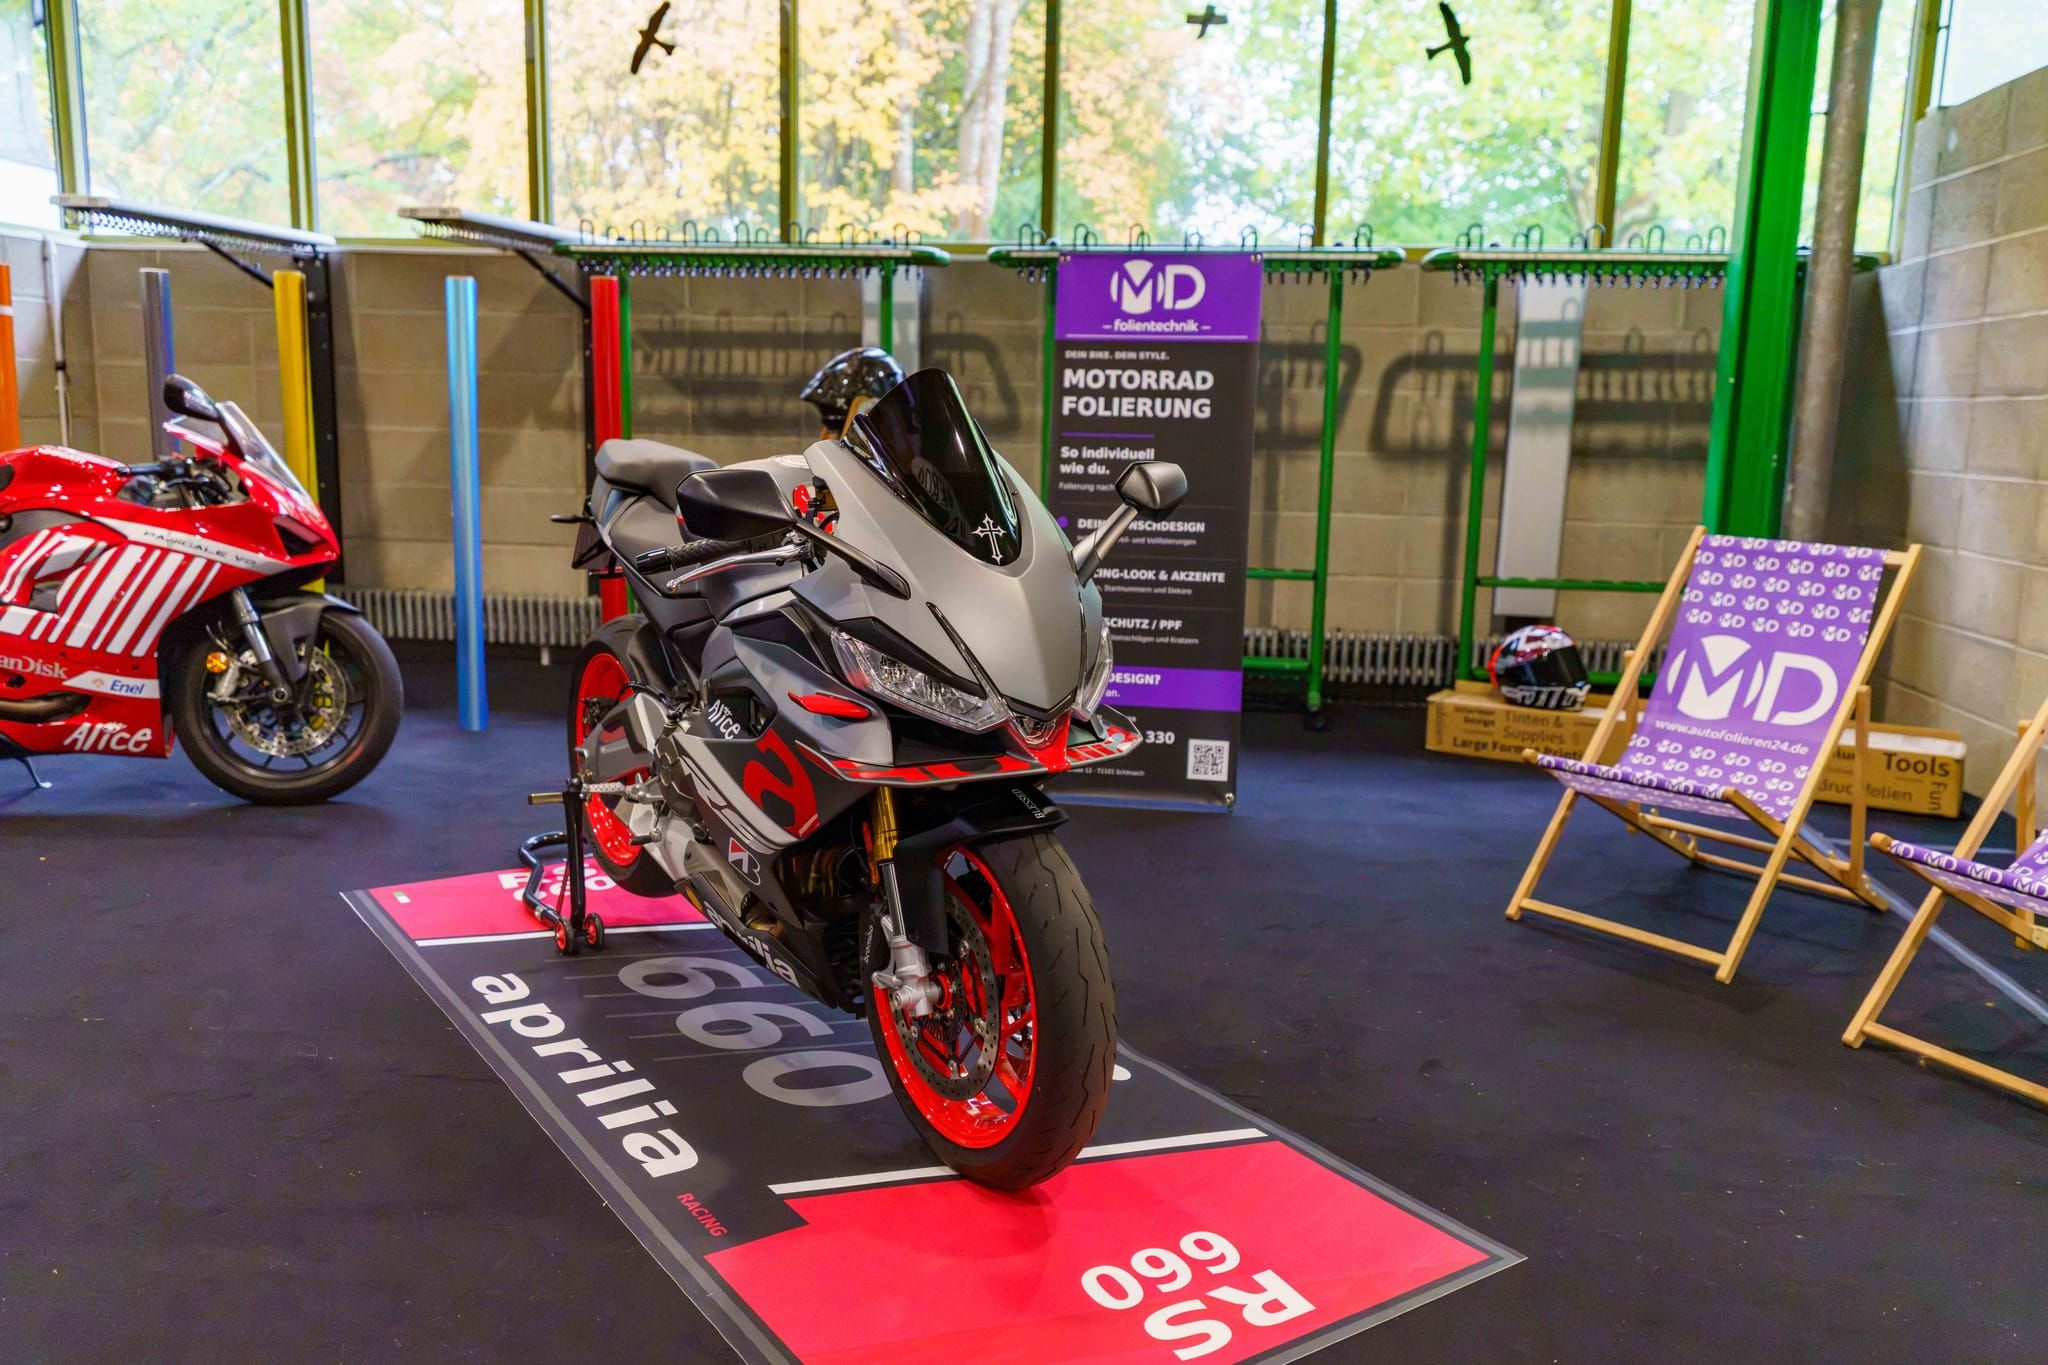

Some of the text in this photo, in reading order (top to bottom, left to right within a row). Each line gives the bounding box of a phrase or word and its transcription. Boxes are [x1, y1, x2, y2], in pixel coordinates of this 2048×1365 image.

[1110, 259, 1206, 315] MD
[1113, 318, 1199, 332] folientechnik
[1065, 350, 1170, 360] DEIN BIKE. DEIN STYLE.
[1063, 368, 1214, 391] MOTORRAD
[1061, 396, 1211, 419] FOLIERUNG
[1060, 446, 1155, 460] So individuell
[1059, 462, 1110, 475] wie du.
[1093, 568, 1225, 583] CING-LOOK & AKZENTE
[1104, 617, 1150, 629] SCHUTZ
[1159, 619, 1183, 631] PPF
[0, 655, 69, 679] anDisk
[110, 679, 145, 695] Enel
[1666, 634, 1838, 726] MD
[707, 699, 741, 739] Alice
[64, 721, 152, 753] Alice
[1145, 730, 1175, 745] 330
[1655, 719, 1809, 755] www.autofolieren24.de
[1882, 751, 1950, 777] Tools
[471, 973, 699, 1178] aprilia
[677, 1192, 728, 1237] RACING
[1080, 1231, 1241, 1310] 660
[1143, 1269, 1316, 1361] RS
